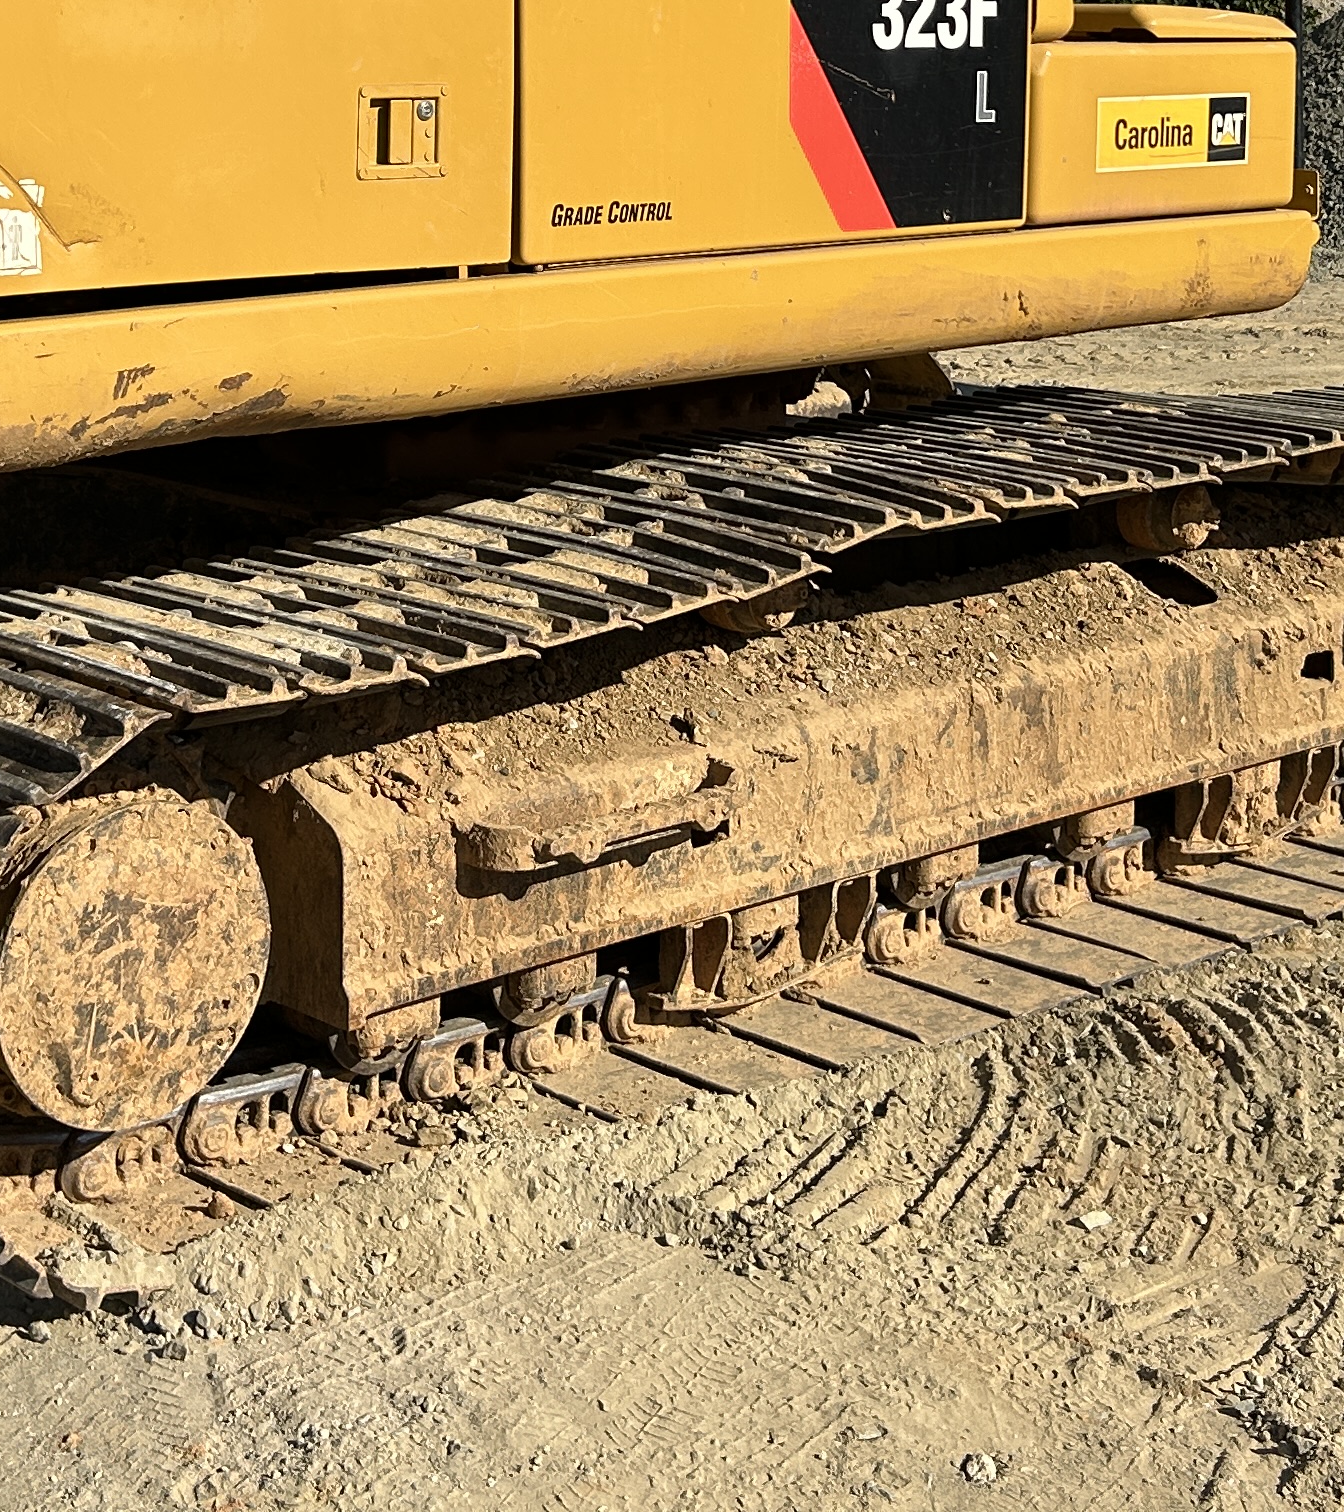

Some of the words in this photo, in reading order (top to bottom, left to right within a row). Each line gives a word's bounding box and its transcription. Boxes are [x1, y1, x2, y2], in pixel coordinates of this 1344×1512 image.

[975, 70, 996, 123] L
[1114, 116, 1193, 151] Carolina
[1211, 112, 1245, 147] CAT
[551, 203, 604, 228] GRADE
[607, 200, 673, 224] CONTROL
